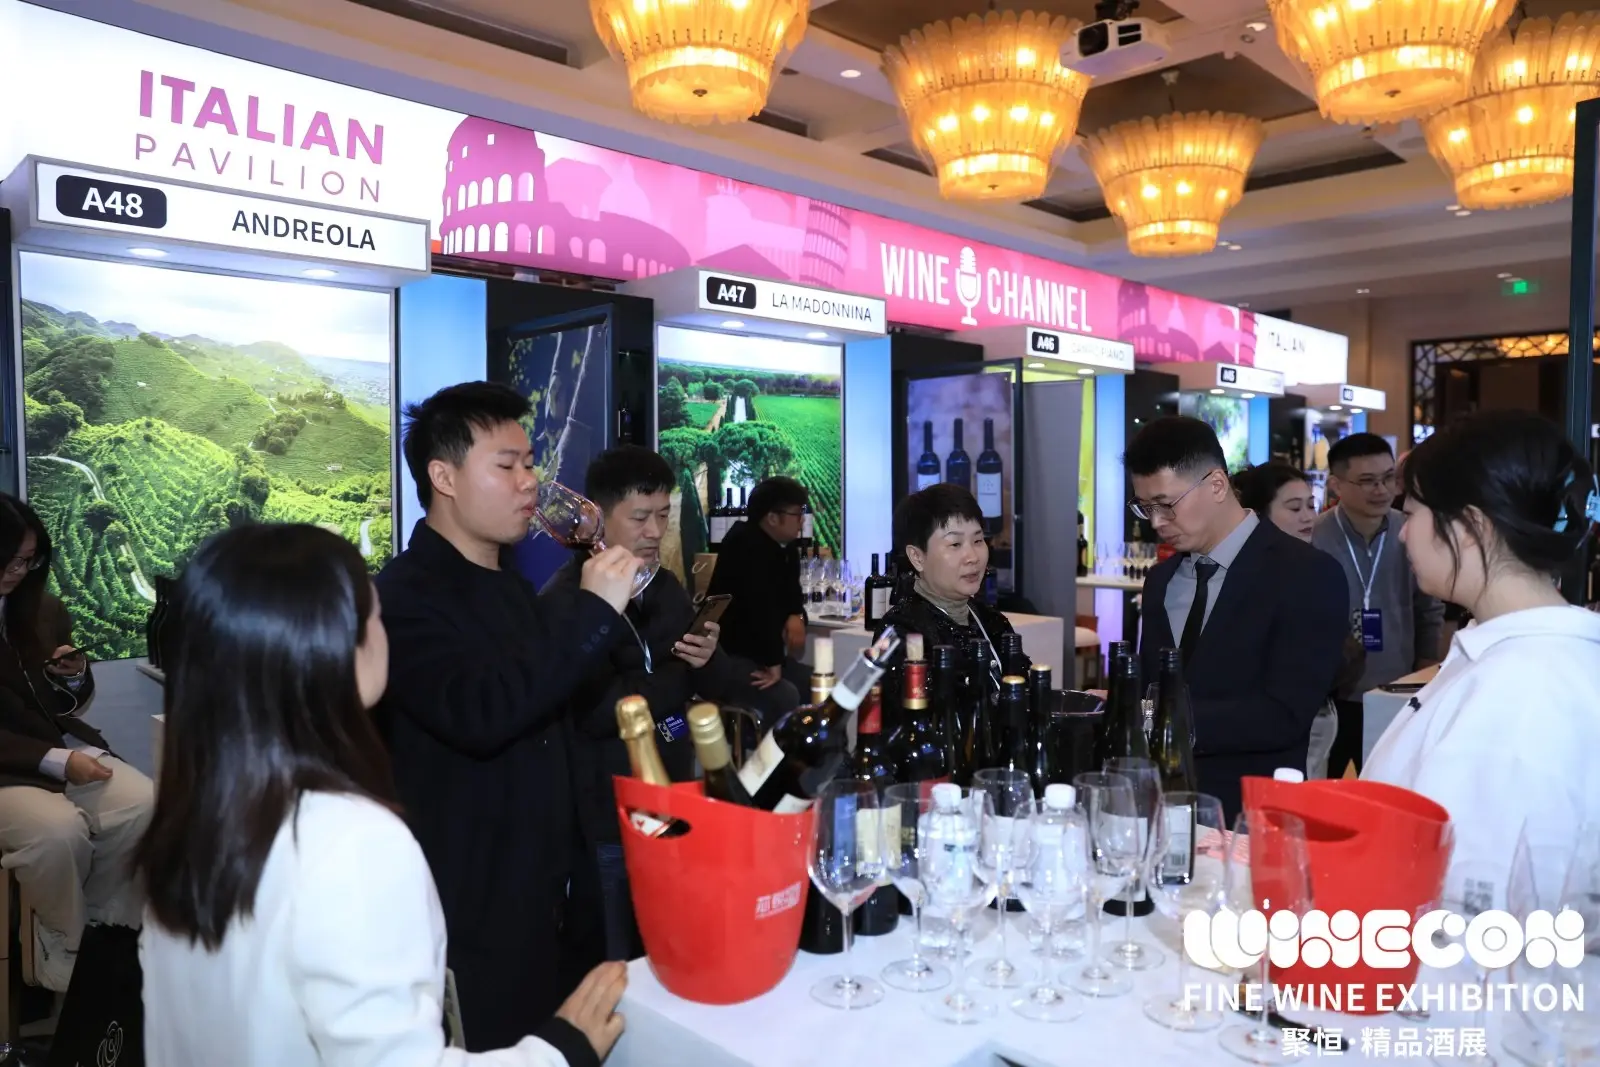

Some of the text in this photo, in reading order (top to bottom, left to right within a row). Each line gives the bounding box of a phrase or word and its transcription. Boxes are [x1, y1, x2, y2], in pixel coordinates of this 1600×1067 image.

[140, 70, 384, 165] ITALIAN
[135, 133, 380, 203] PAVILION
[81, 187, 144, 219] A48
[232, 209, 376, 251] ANDREOLA
[717, 283, 747, 304] A47
[880, 242, 1093, 332] WINE CHANNEL
[772, 292, 872, 322] LA MADONNINA
[1036, 335, 1055, 351] A46
